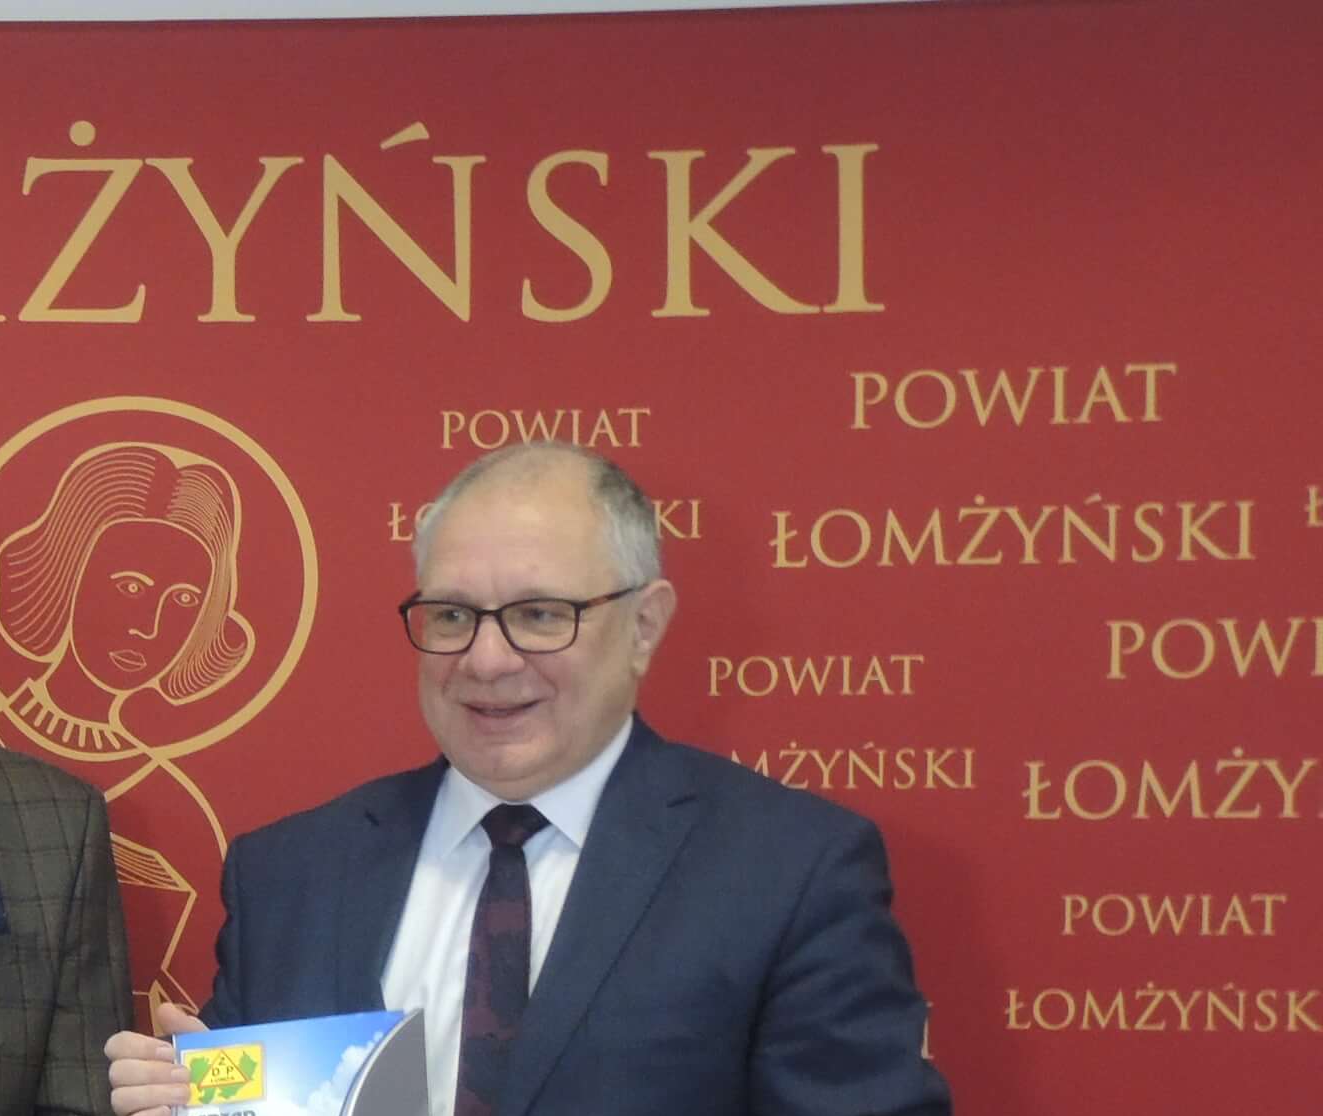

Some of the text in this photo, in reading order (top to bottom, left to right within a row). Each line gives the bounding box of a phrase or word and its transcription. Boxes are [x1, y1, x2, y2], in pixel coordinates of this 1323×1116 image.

[849, 362, 1180, 431] POWIAT
[440, 407, 651, 450] POWIAT
[769, 494, 1255, 569] ŁOMŻYŃSKI
[707, 655, 925, 697] POWIAT
[1106, 616, 1323, 680] POWI
[1022, 745, 1323, 822] ŁOMŻY
[1062, 894, 1290, 937] POWIAT
[1004, 981, 1323, 1033] ŁOMŻYŃSK
